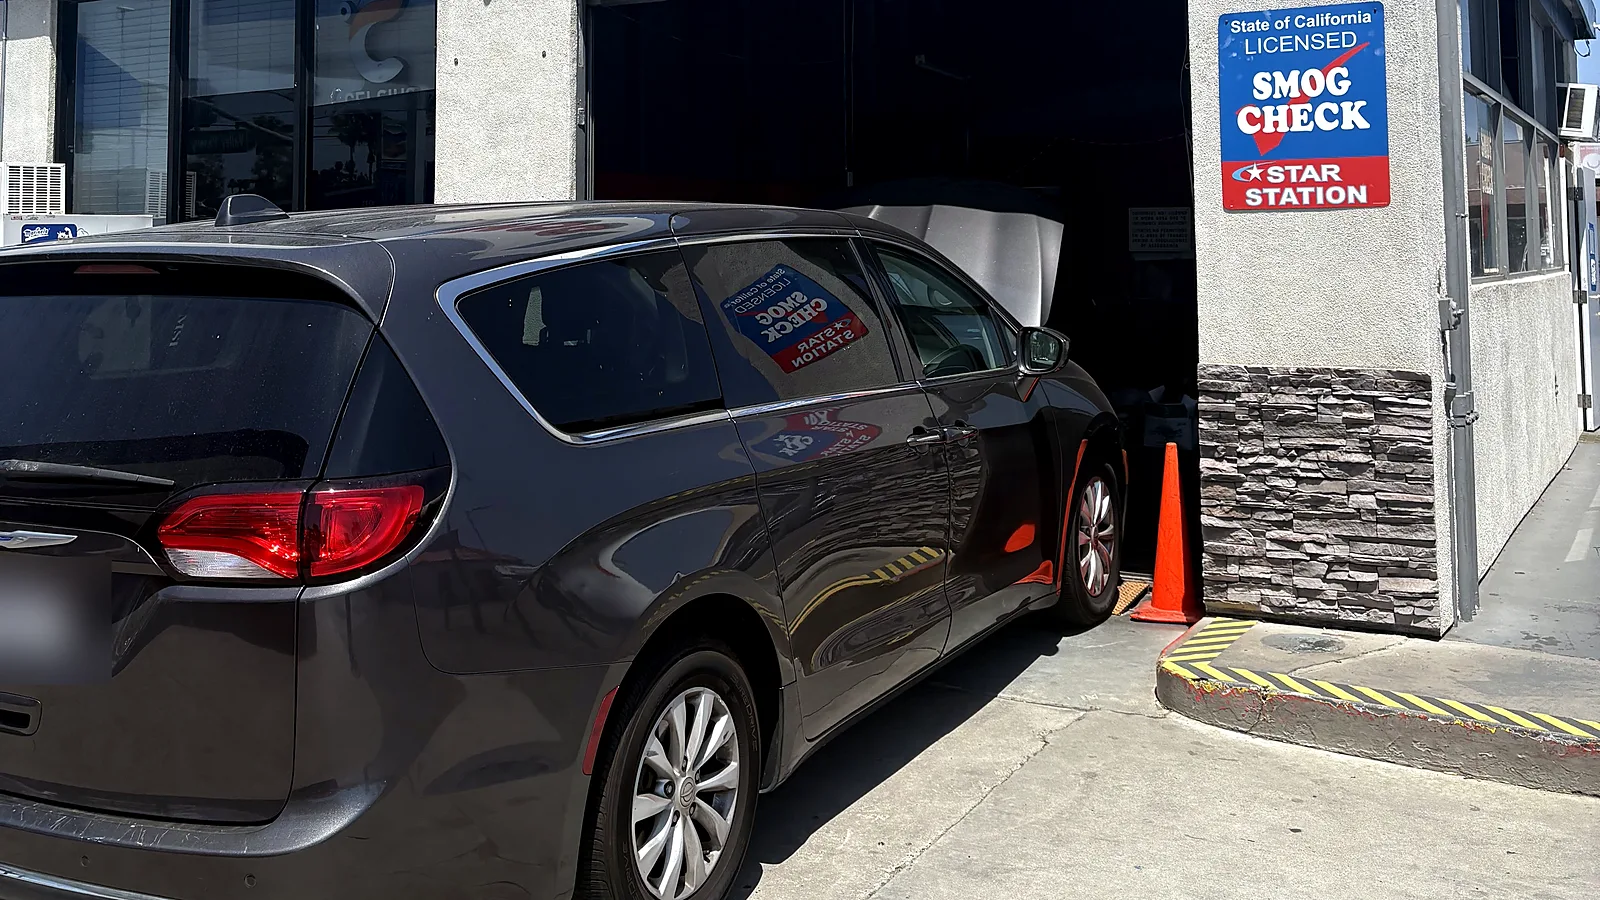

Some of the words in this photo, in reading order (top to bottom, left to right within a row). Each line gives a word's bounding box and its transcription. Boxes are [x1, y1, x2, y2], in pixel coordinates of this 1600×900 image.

[1230, 20, 1270, 34] State
[1274, 18, 1290, 30] of
[1294, 10, 1372, 28] California
[1245, 31, 1357, 55] LICENSED
[1252, 66, 1352, 100] SMOG
[1237, 100, 1371, 135] CHECK
[1266, 164, 1343, 184] STAR
[1245, 185, 1368, 207] STATION
